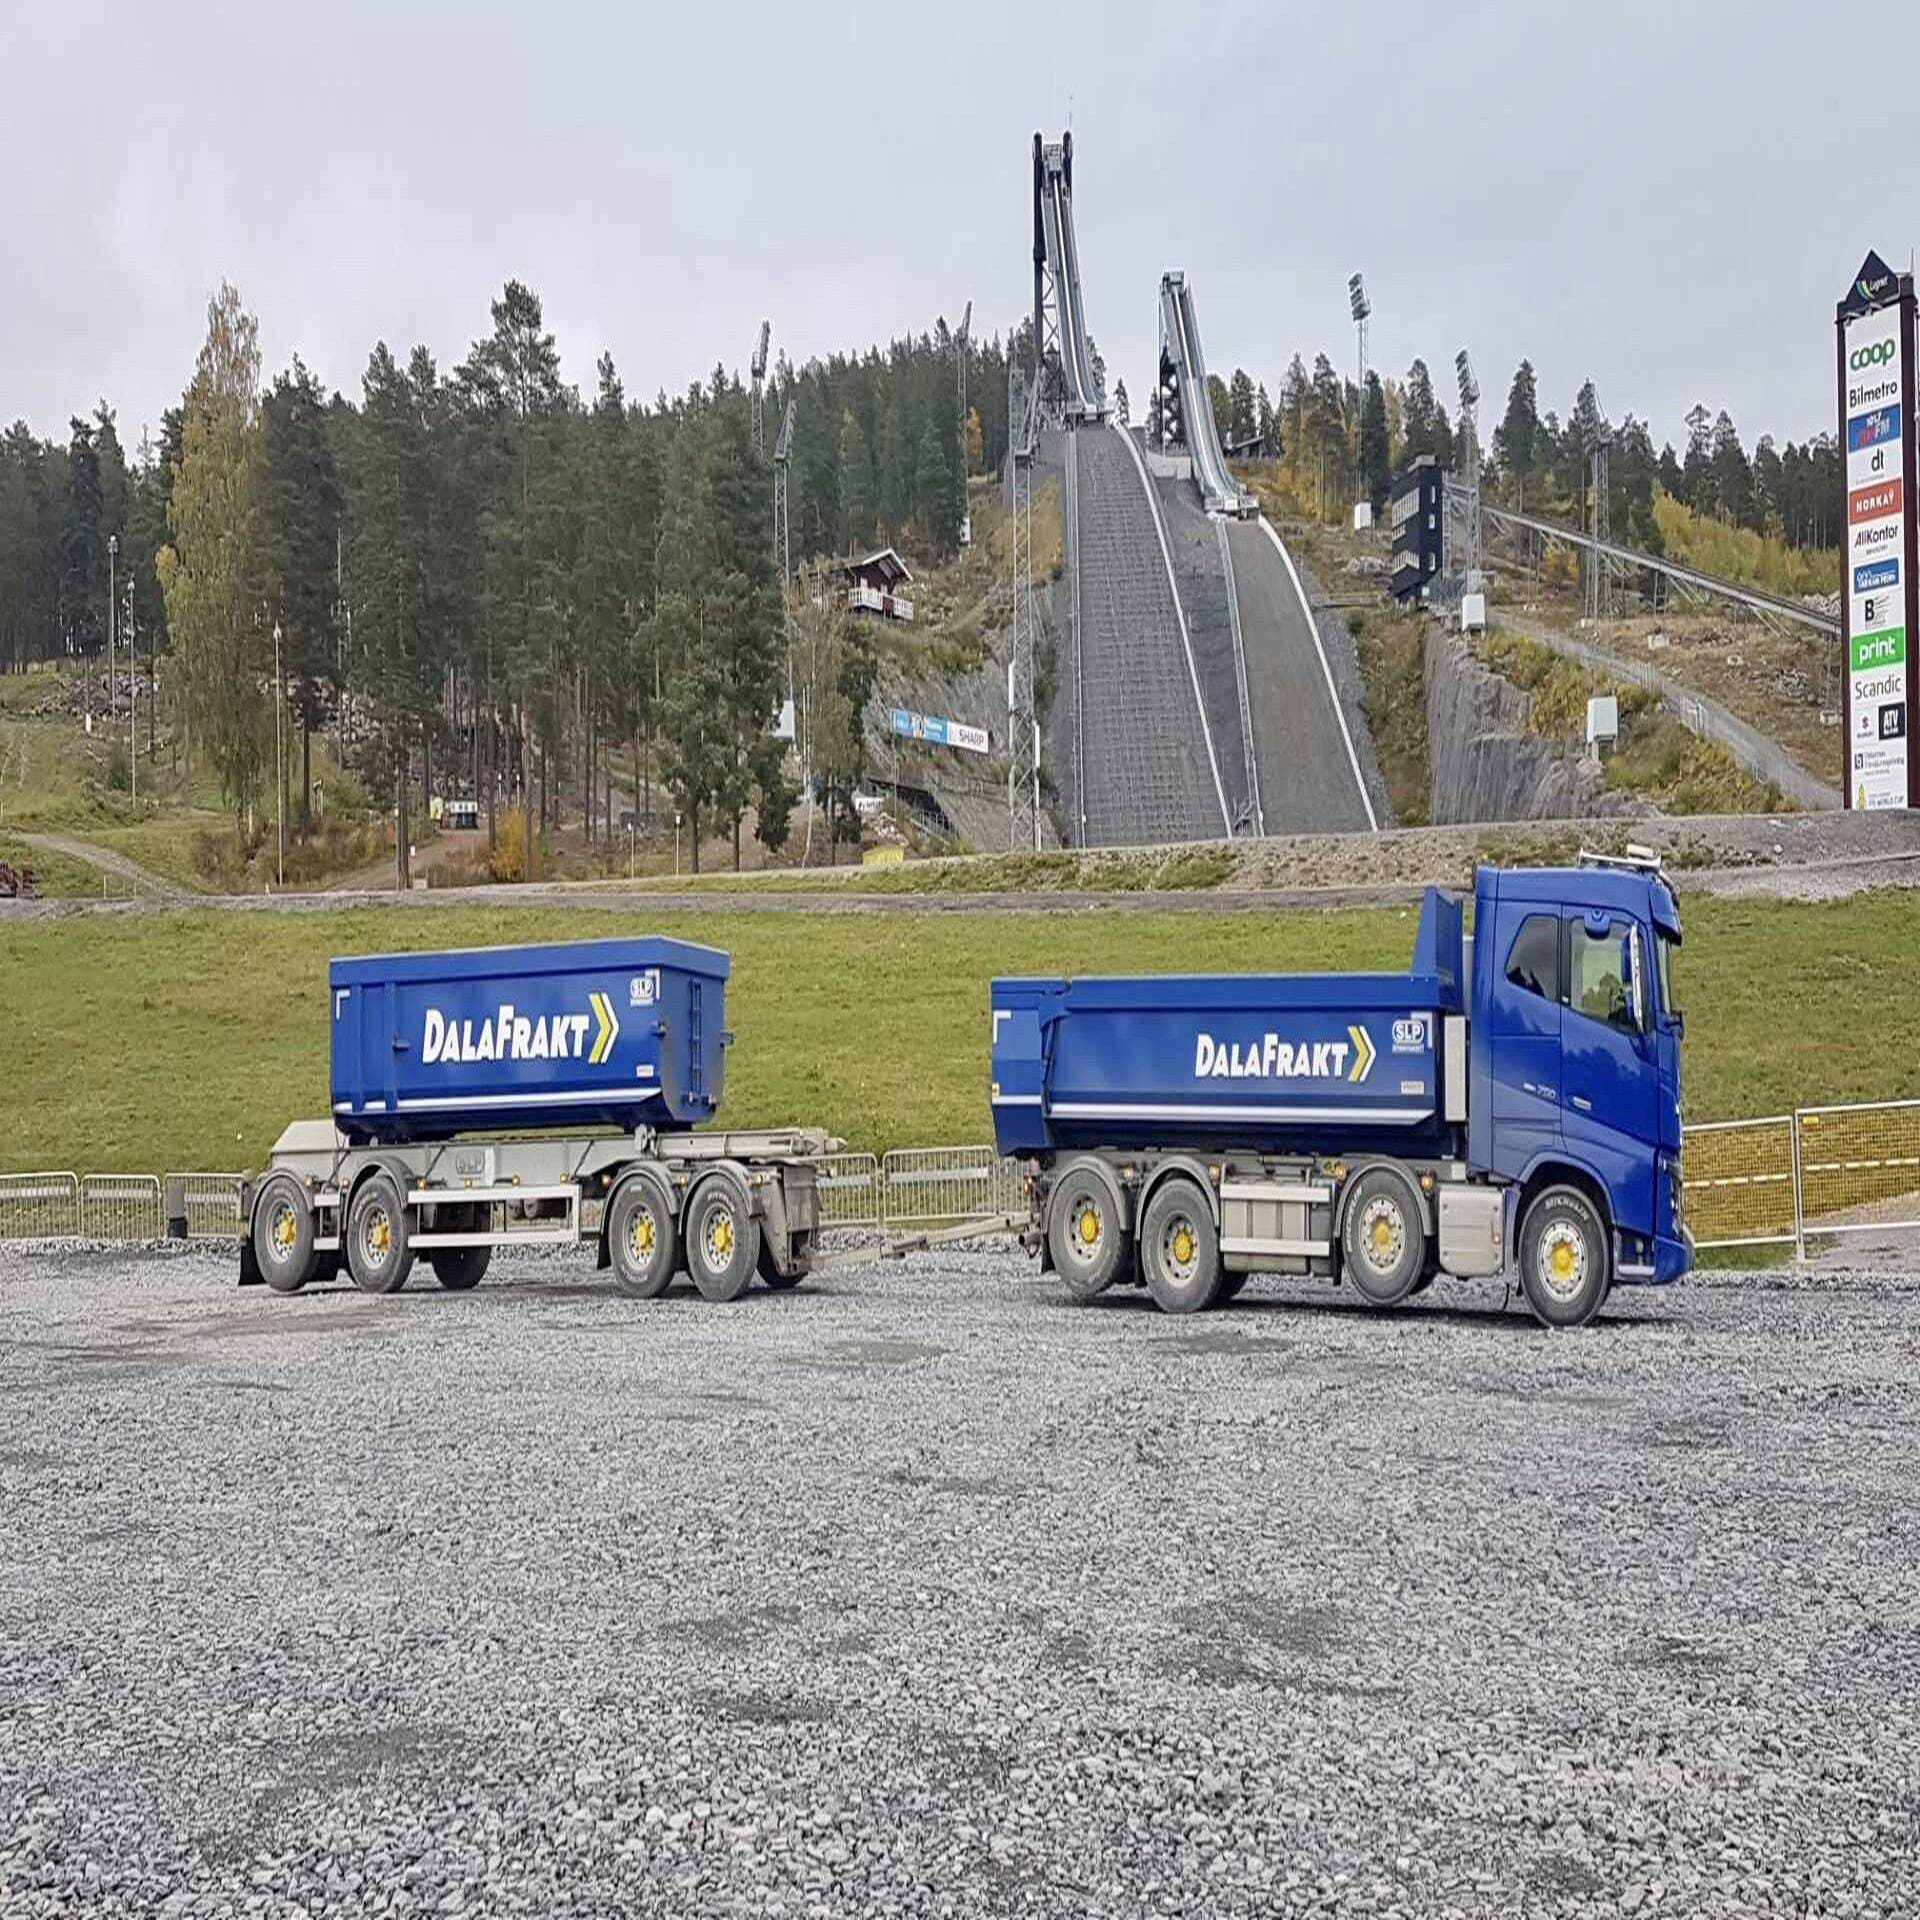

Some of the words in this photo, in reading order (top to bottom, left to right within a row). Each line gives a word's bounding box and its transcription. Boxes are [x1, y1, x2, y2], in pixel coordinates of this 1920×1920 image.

[1850, 338, 1896, 371] coop
[1849, 380, 1898, 408] Bilmetro
[1855, 524, 1898, 548] AllKontor
[1865, 599, 1875, 621] B
[1855, 674, 1901, 700] Scandic
[1395, 1023, 1421, 1041] SLP
